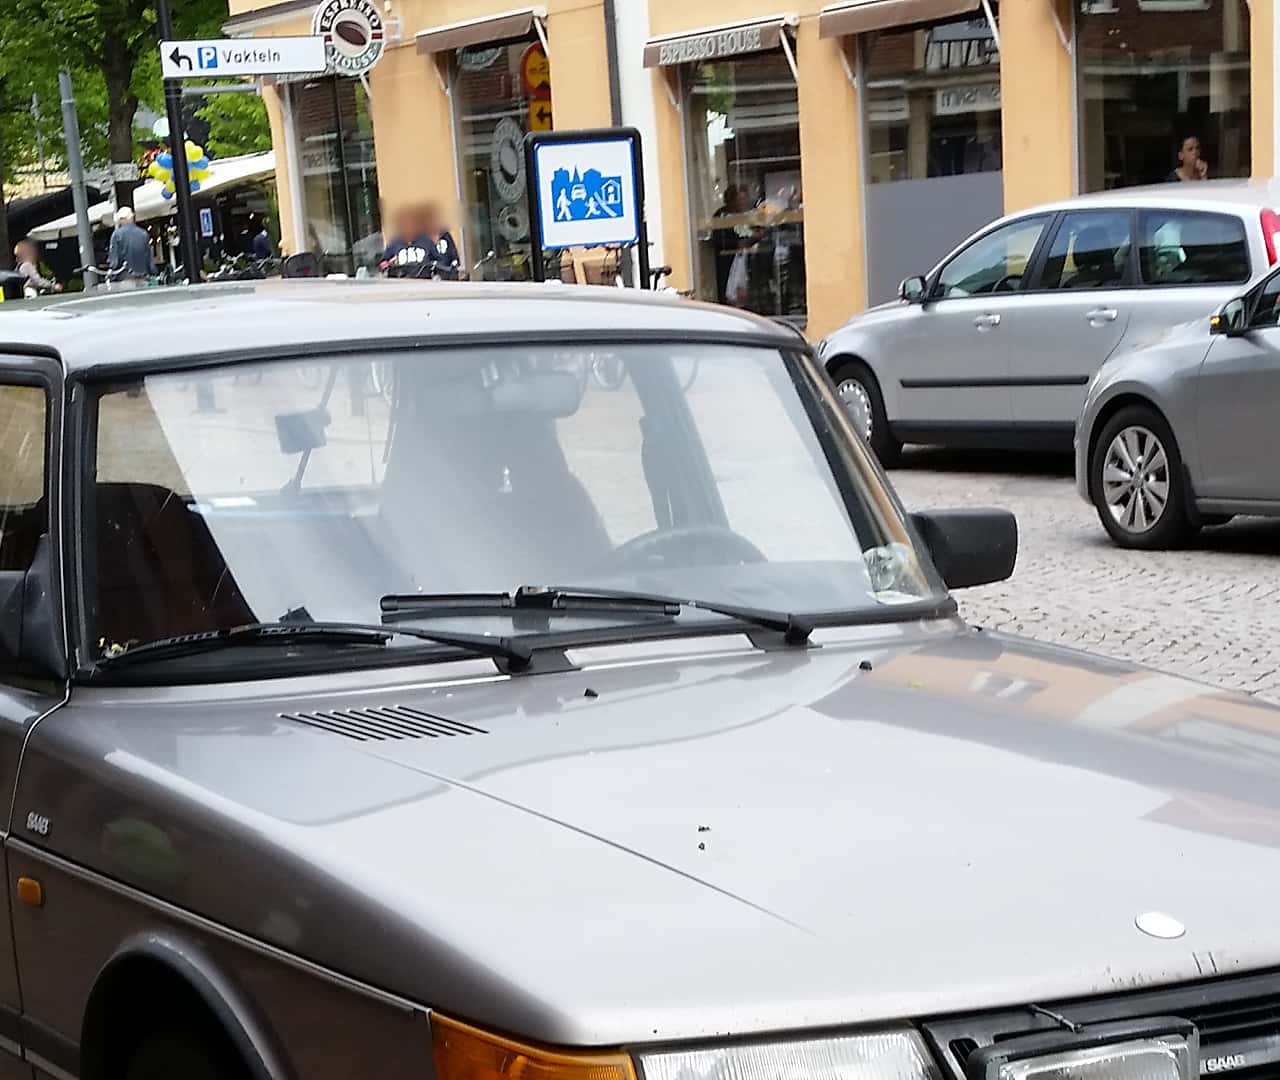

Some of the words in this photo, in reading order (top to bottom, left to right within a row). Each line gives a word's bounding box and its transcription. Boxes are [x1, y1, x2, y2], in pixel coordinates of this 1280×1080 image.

[660, 36, 716, 64] ESPRESSO
[717, 28, 761, 55] HOUSE
[223, 49, 281, 64] Vakteln
[331, 47, 378, 69] HOUSE
[1206, 1054, 1246, 1071] SAAB
